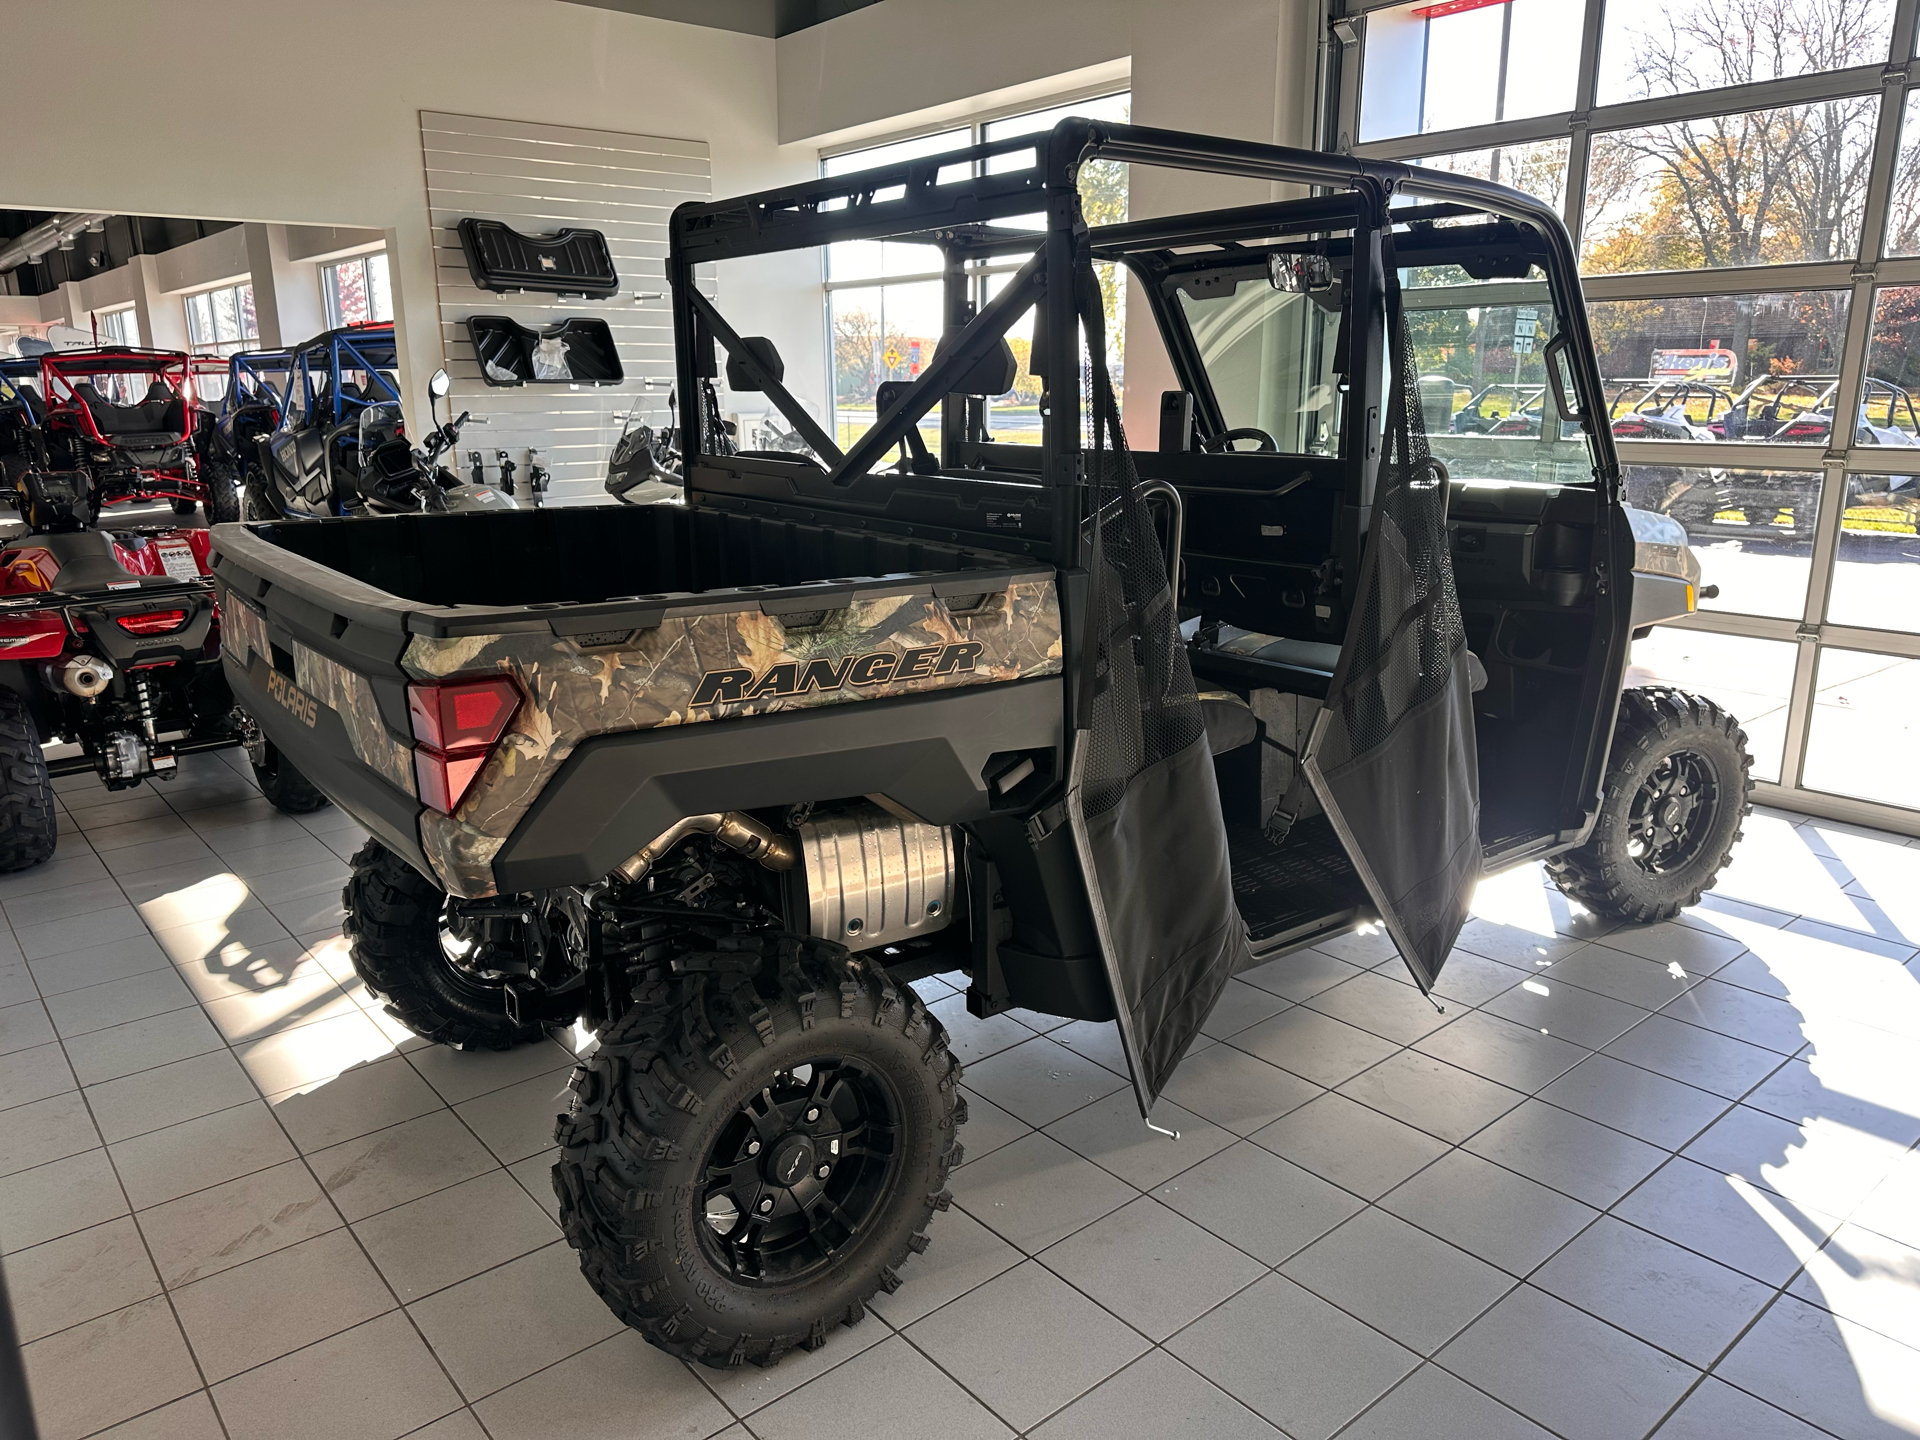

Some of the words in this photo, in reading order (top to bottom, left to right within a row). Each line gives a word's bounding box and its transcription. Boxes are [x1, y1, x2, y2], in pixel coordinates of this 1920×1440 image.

[135, 636, 180, 648] HONDA
[266, 669, 318, 729] POLARIS
[687, 641, 984, 708] RANGER
